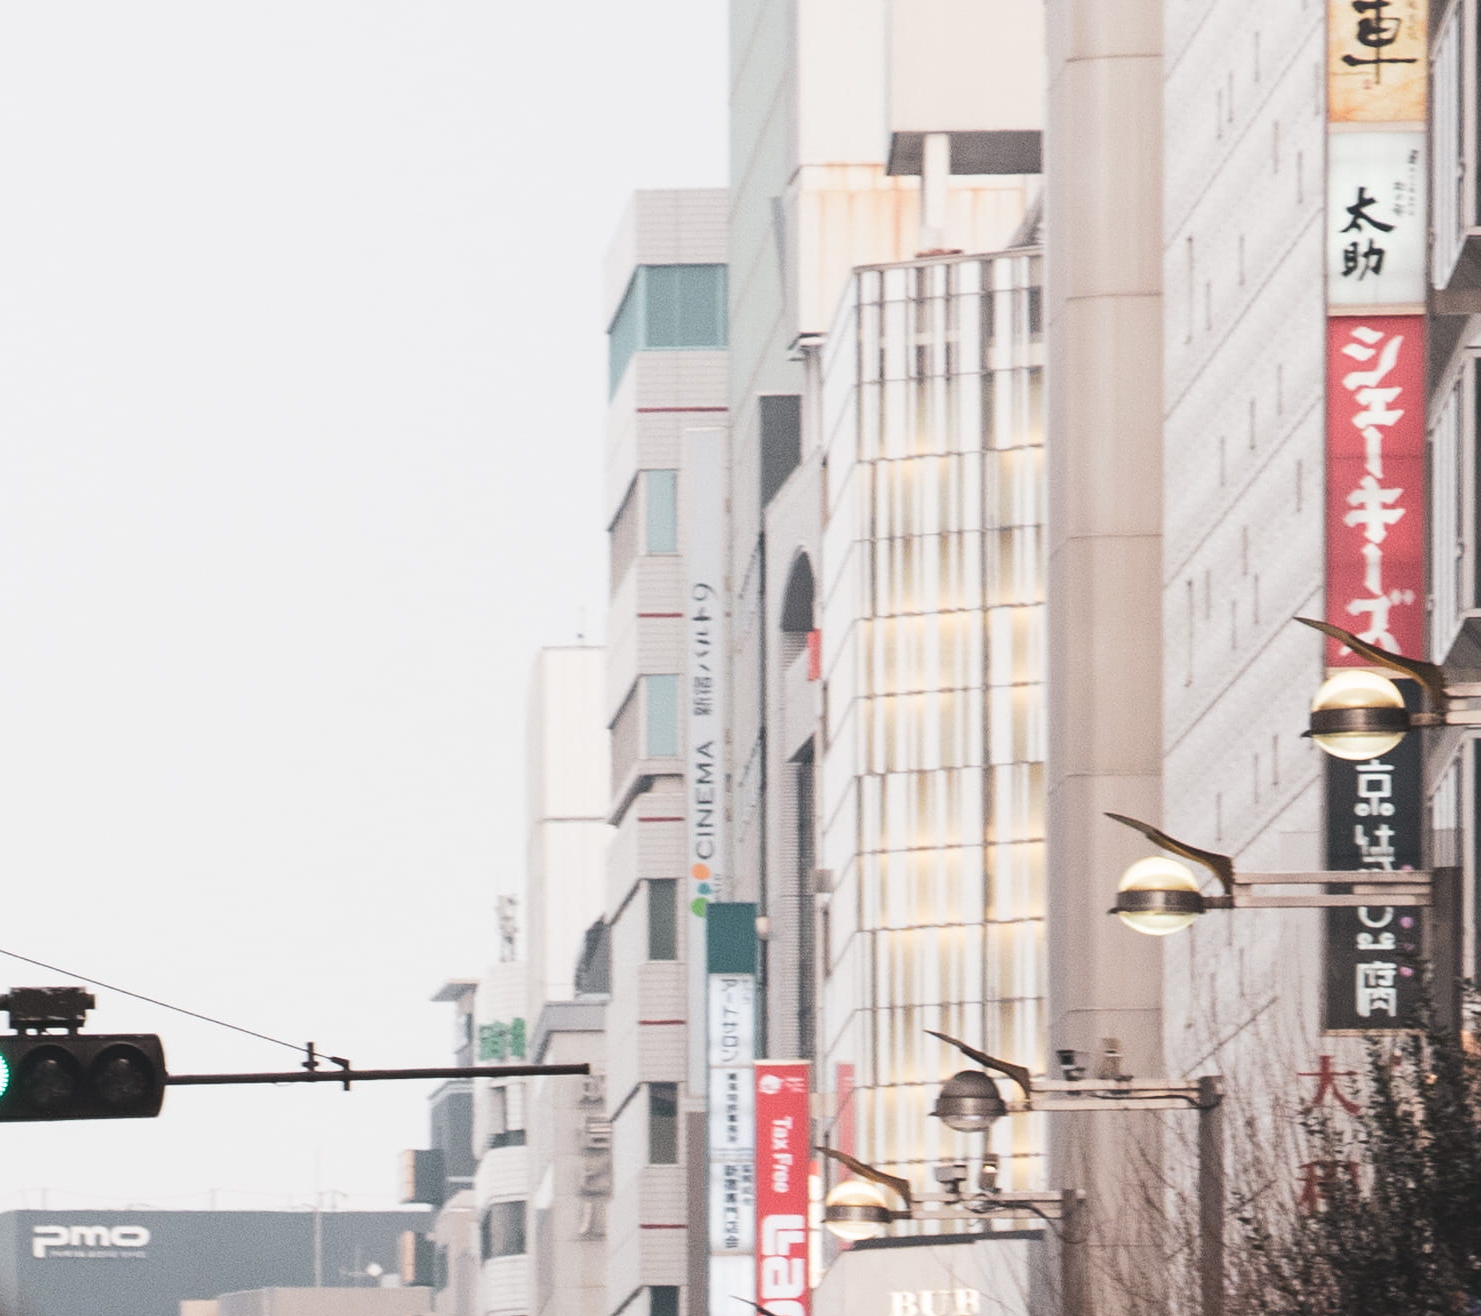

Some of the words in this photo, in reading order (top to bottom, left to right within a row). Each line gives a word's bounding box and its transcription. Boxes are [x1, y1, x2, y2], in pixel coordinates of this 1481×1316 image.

[1339, 185, 1396, 281] 太助
[1340, 326, 1417, 658] シェーキーズ
[694, 740, 717, 861] CINEMA
[771, 1115, 794, 1149] Tax
[771, 1153, 794, 1194] Free
[32, 1224, 152, 1259] pmo
